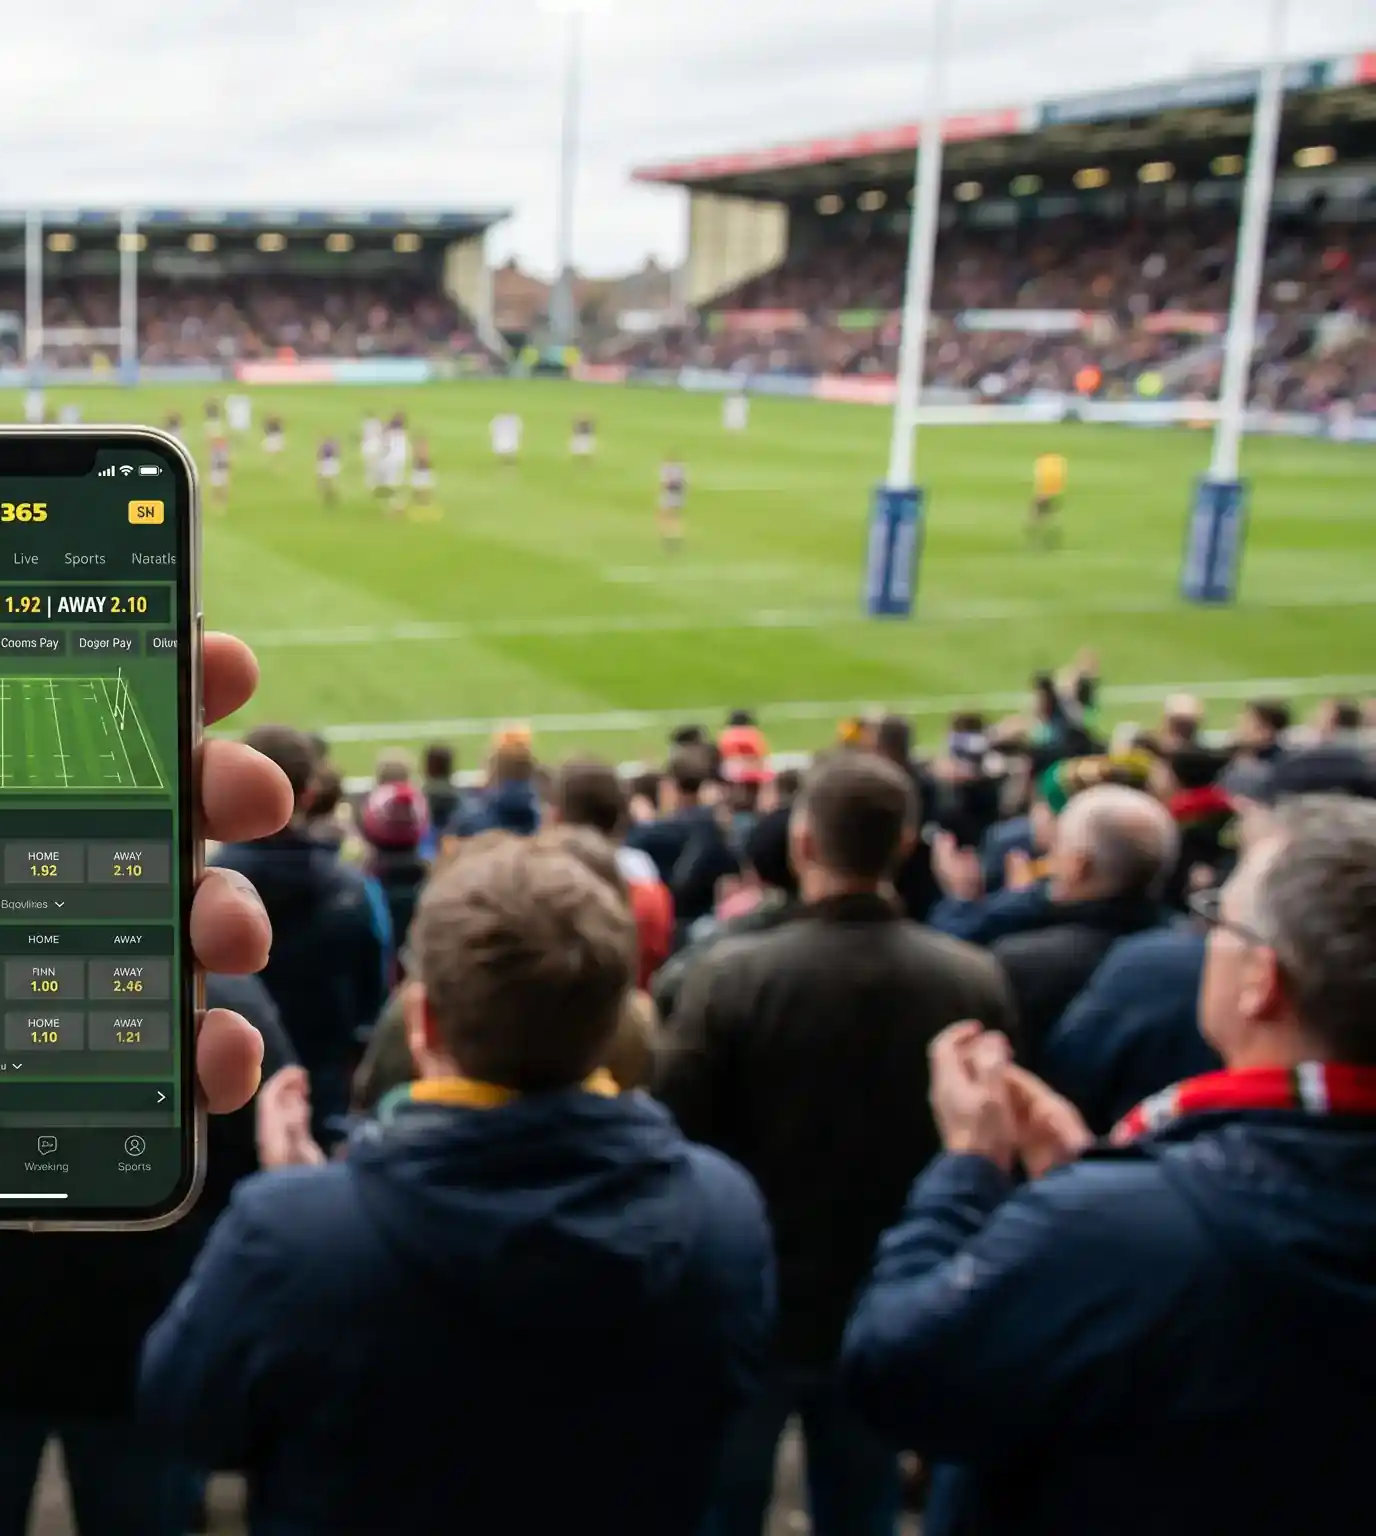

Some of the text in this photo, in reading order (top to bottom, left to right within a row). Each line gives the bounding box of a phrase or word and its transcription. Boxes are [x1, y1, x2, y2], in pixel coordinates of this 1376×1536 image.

[14, 553, 39, 565] Live
[64, 553, 106, 567] Sports
[6, 596, 41, 613] 1.92
[57, 596, 106, 613] AWAY
[110, 596, 148, 613] 2.10
[40, 638, 59, 651] Pay
[113, 638, 132, 651] Pay
[28, 852, 60, 860] HOME
[113, 852, 142, 860] AWAY
[30, 864, 57, 876] 1.92
[113, 864, 142, 876] 2.10
[28, 934, 60, 944] HOME
[114, 934, 142, 944] AWAY
[113, 968, 144, 976] AWAY
[30, 980, 58, 992] 1.00
[113, 980, 144, 992] 2.46
[28, 1018, 60, 1028] HOME
[113, 1018, 144, 1028] AWAY
[30, 1032, 58, 1043] 1.10
[116, 1032, 142, 1043] 1.21
[118, 1162, 152, 1173] Sports
